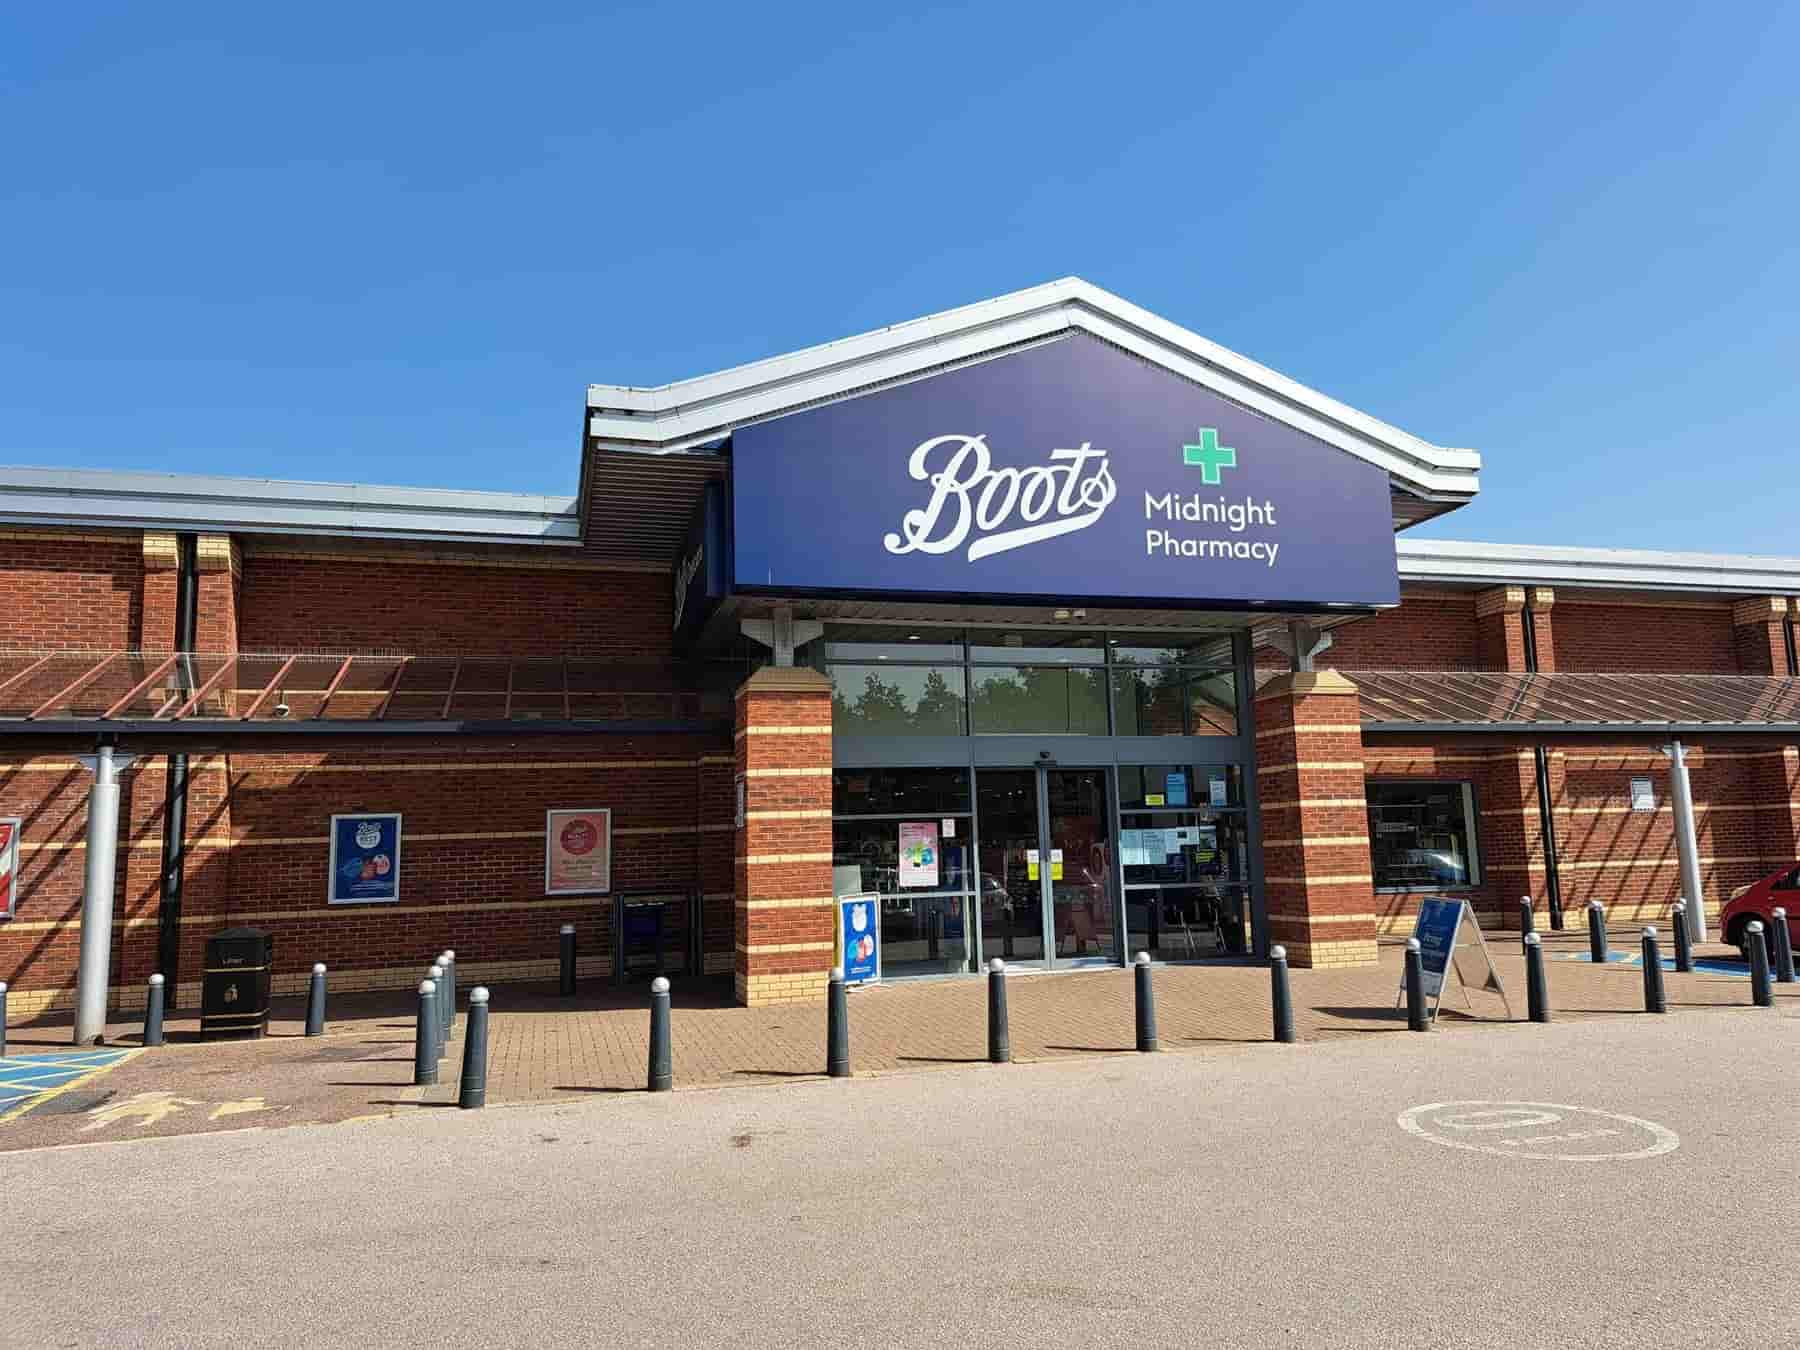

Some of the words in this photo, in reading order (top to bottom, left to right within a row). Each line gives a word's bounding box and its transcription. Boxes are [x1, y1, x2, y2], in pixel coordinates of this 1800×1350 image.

[884, 434, 1117, 562] Boots
[1145, 491, 1277, 532] Midnight
[1146, 530, 1279, 567] Pharmacy
